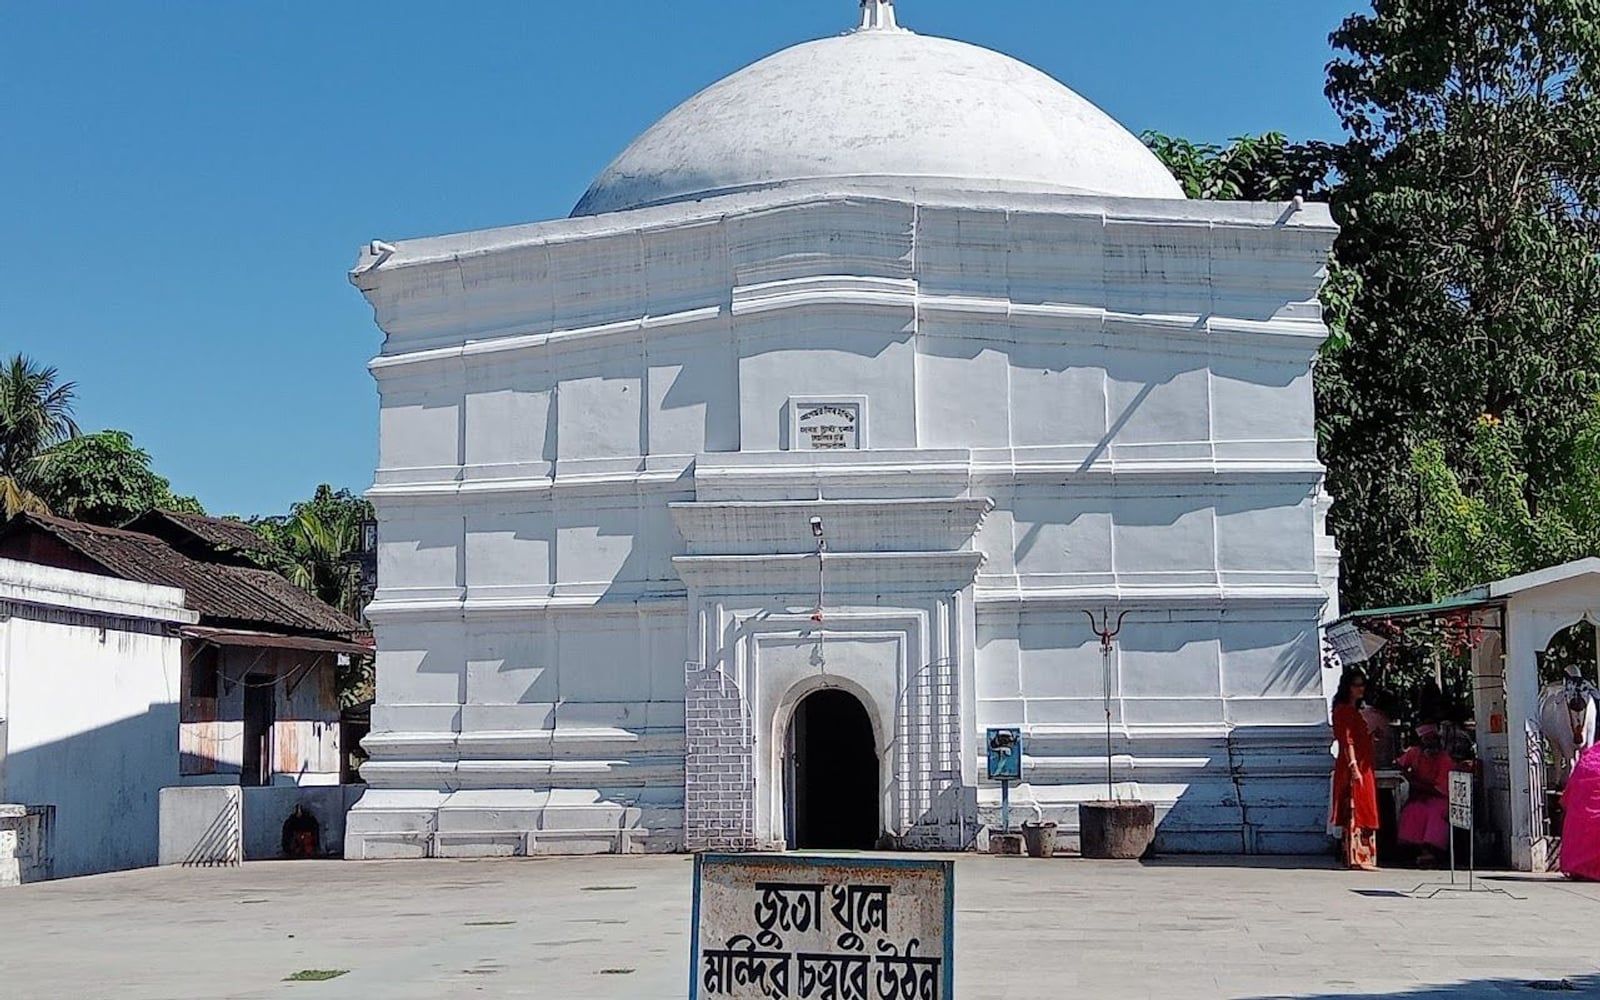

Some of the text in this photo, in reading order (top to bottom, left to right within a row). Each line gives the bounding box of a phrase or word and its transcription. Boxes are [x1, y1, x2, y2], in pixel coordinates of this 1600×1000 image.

[755, 882, 891, 951] জুতা খুলে
[703, 935, 791, 1000] মন্দির
